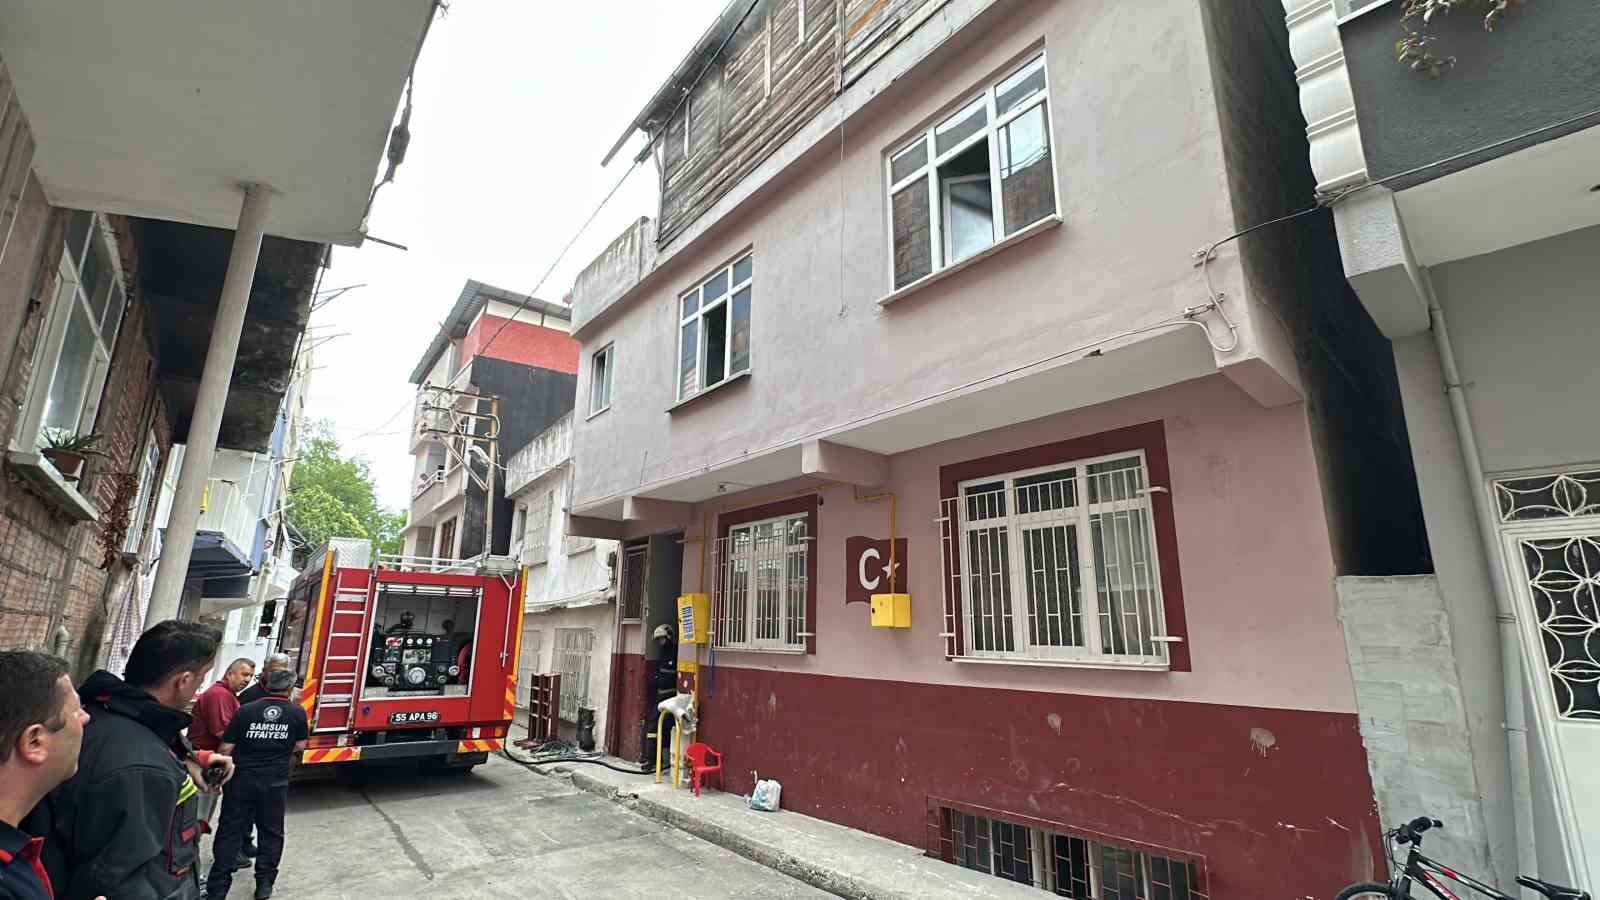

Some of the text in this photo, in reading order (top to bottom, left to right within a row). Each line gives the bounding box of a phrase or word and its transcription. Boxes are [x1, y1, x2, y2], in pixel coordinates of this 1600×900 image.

[395, 713, 407, 722] 55
[408, 712, 425, 721] APA
[249, 723, 289, 732] SAMSUN
